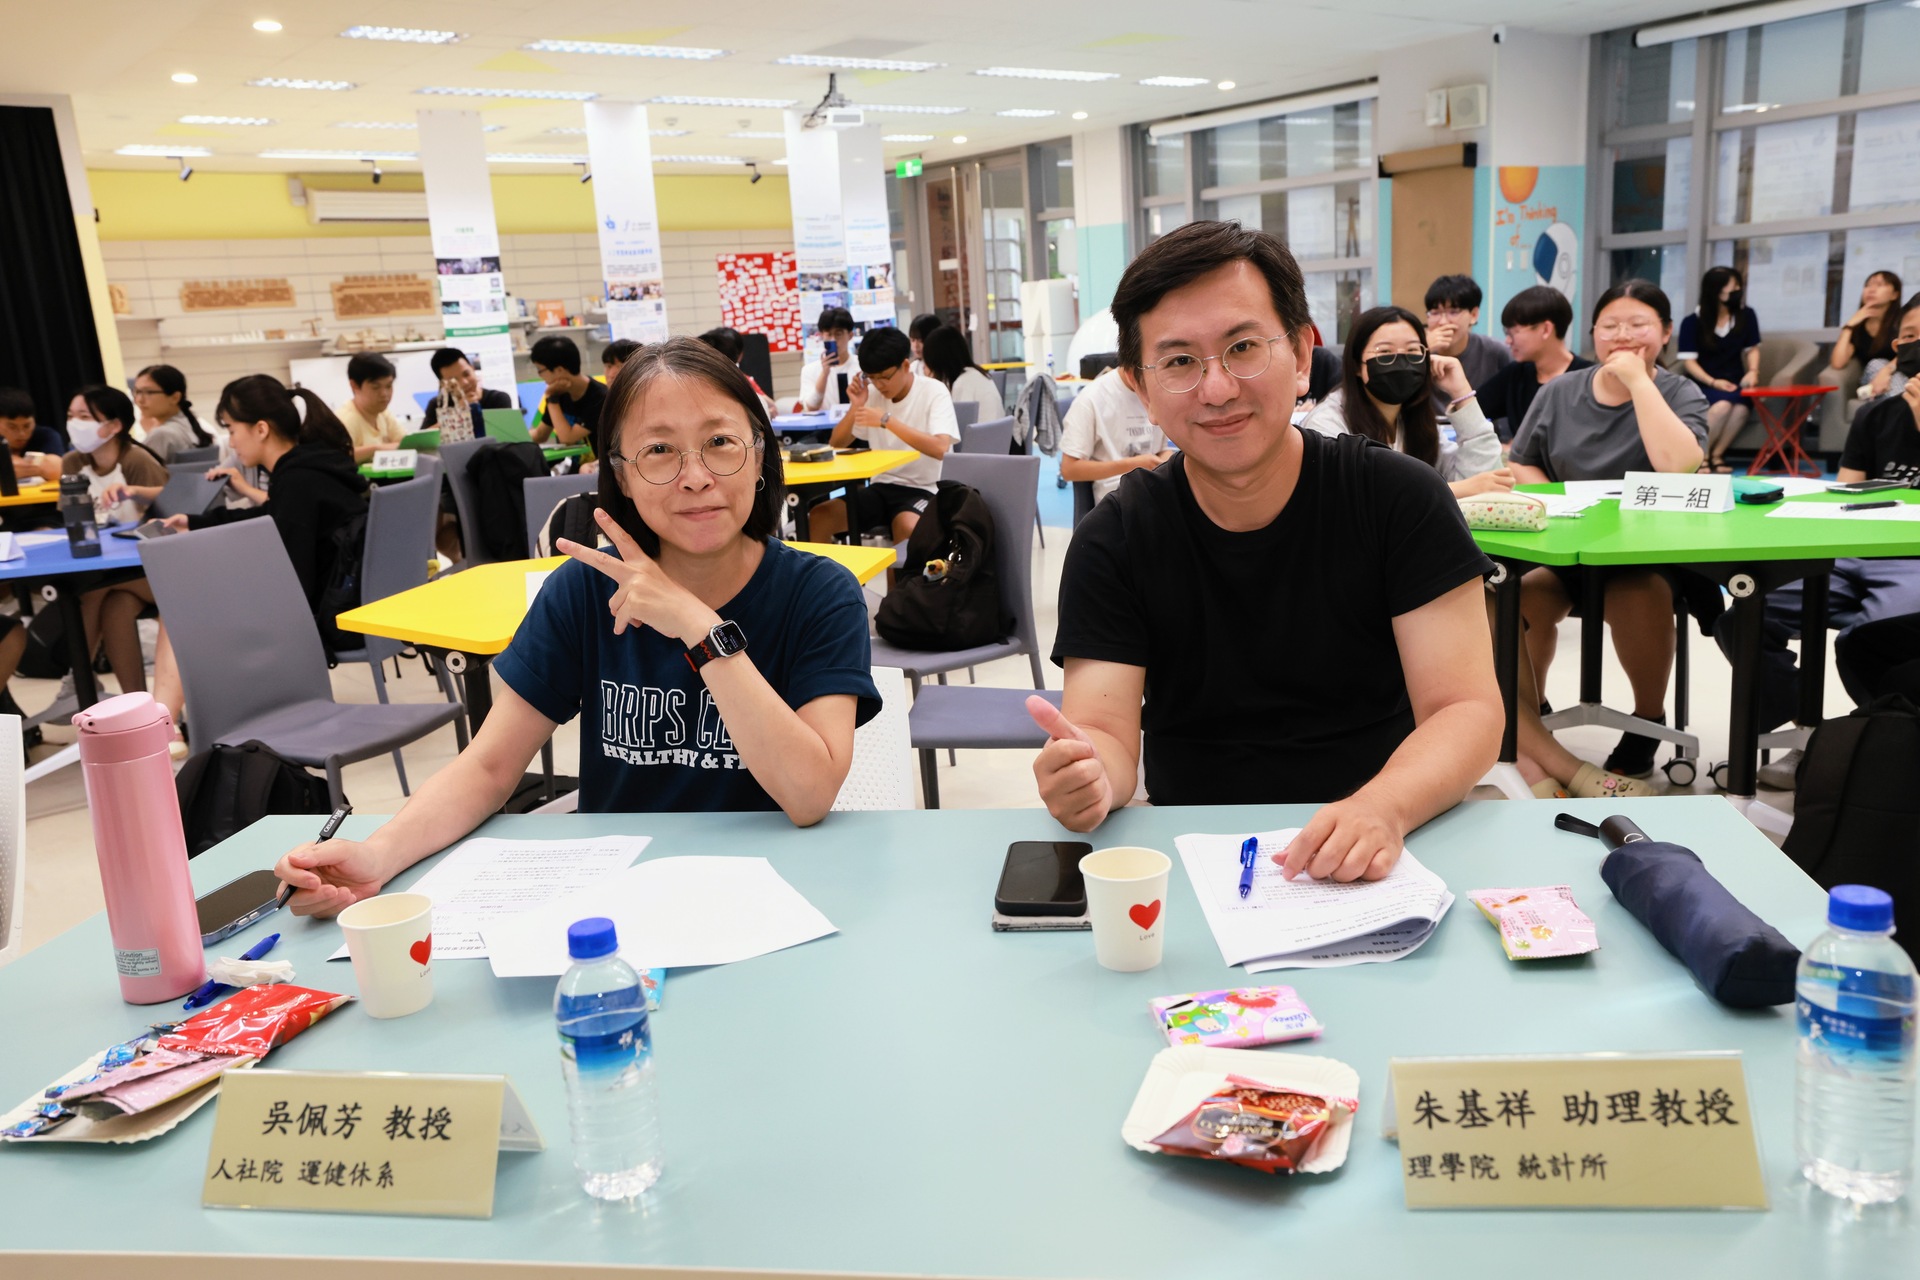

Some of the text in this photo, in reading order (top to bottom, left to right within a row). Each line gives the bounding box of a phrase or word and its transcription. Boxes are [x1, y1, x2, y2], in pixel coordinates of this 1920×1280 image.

[1633, 485, 1711, 509] 第一組
[601, 680, 686, 748] BRPS
[602, 743, 699, 768] HEALTHY
[700, 753, 719, 769] &
[1139, 932, 1155, 941] Love
[262, 1101, 453, 1141] 吳佩芳 教授
[1413, 1088, 1740, 1129] 朱基祥 助理教授
[211, 1158, 395, 1189] 人社院 運健休系
[1408, 1153, 1609, 1181] 理學院 統計所
